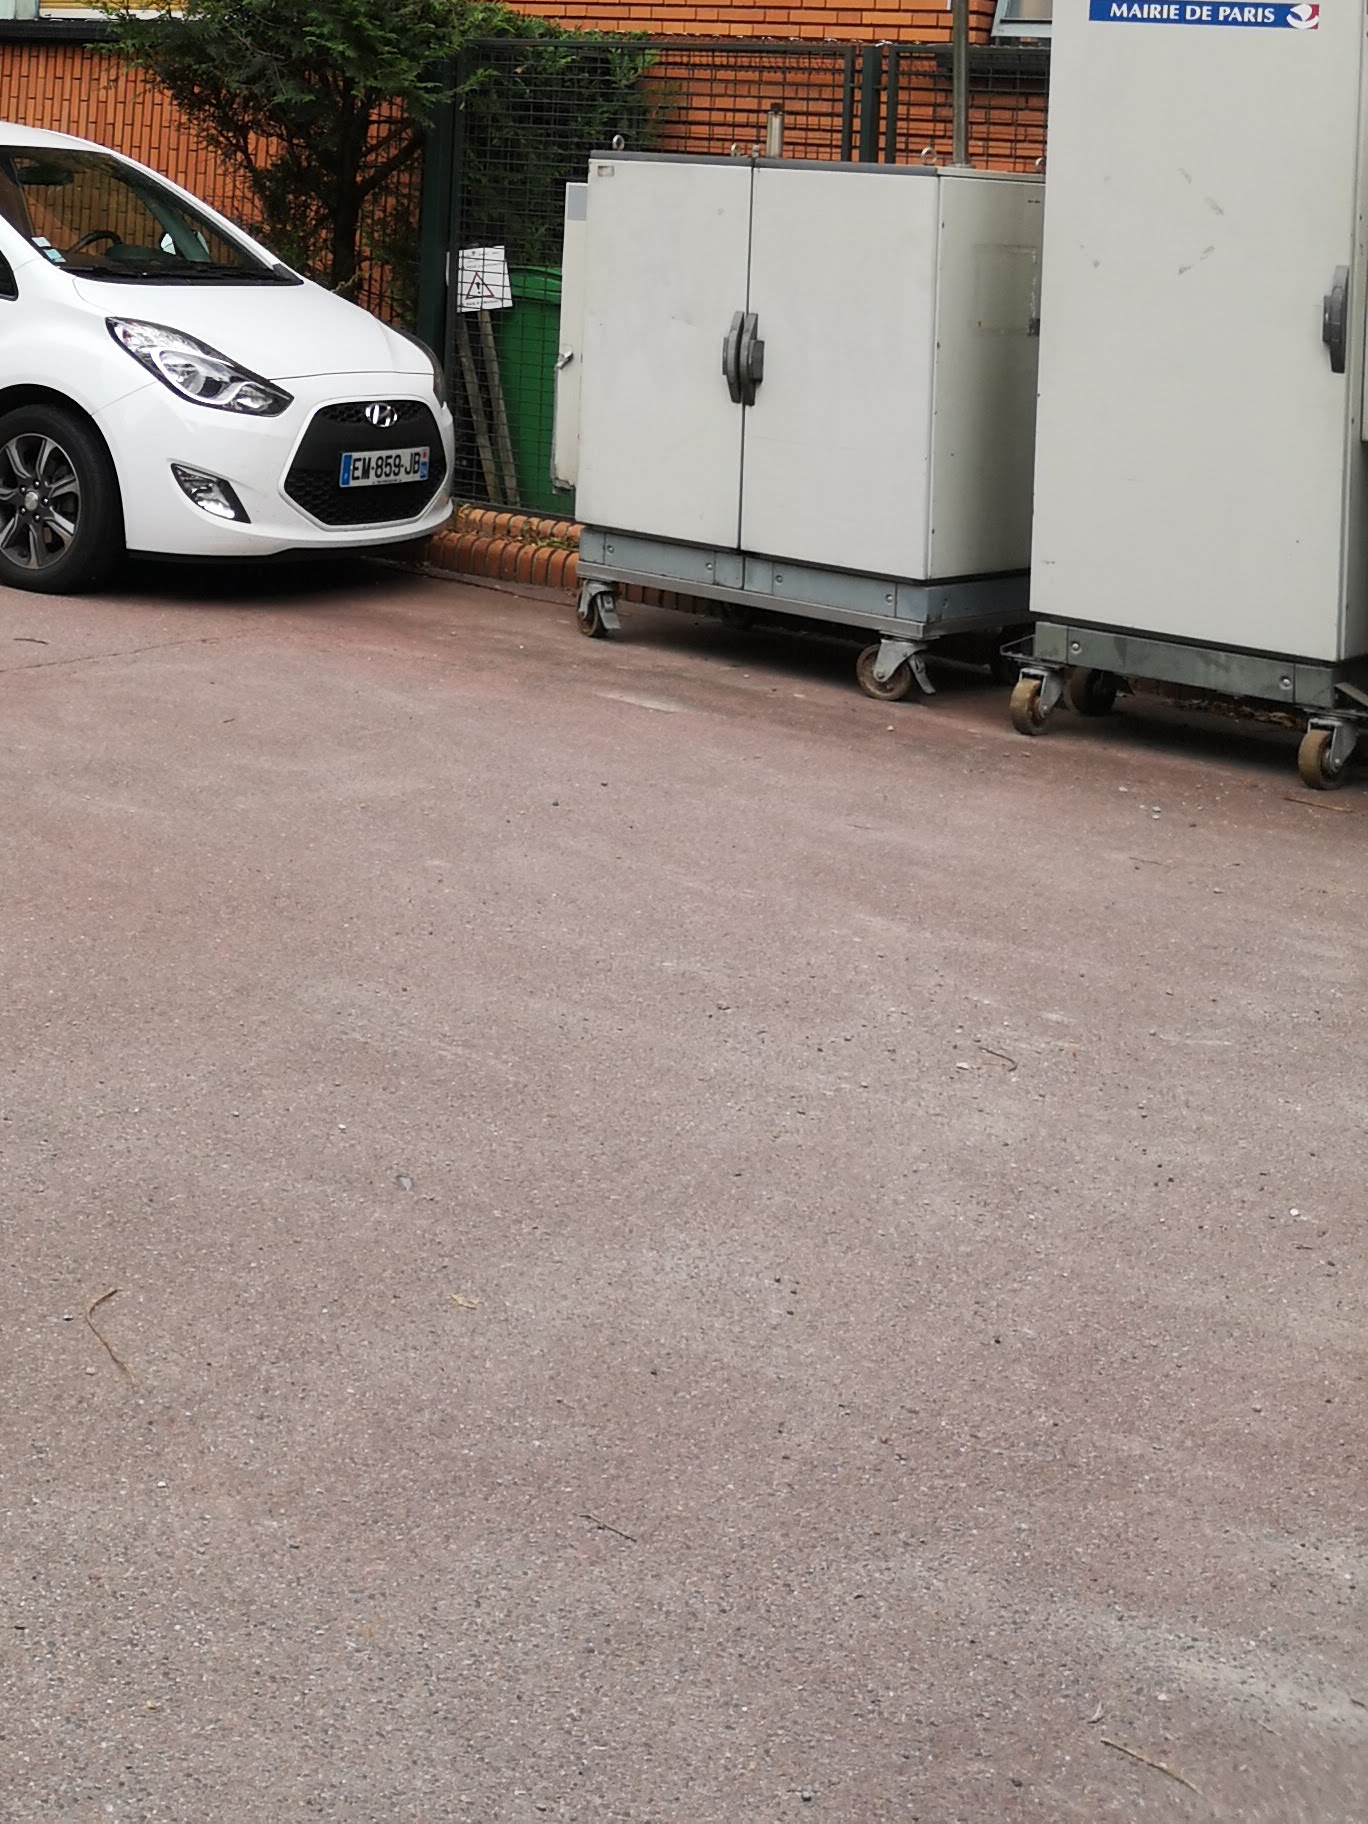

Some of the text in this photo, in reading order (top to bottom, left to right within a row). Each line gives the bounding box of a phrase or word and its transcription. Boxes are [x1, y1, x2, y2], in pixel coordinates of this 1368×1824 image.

[1109, 2, 1276, 23] MAIRIE DE PARIS
[351, 452, 421, 481] EM-859-JB
